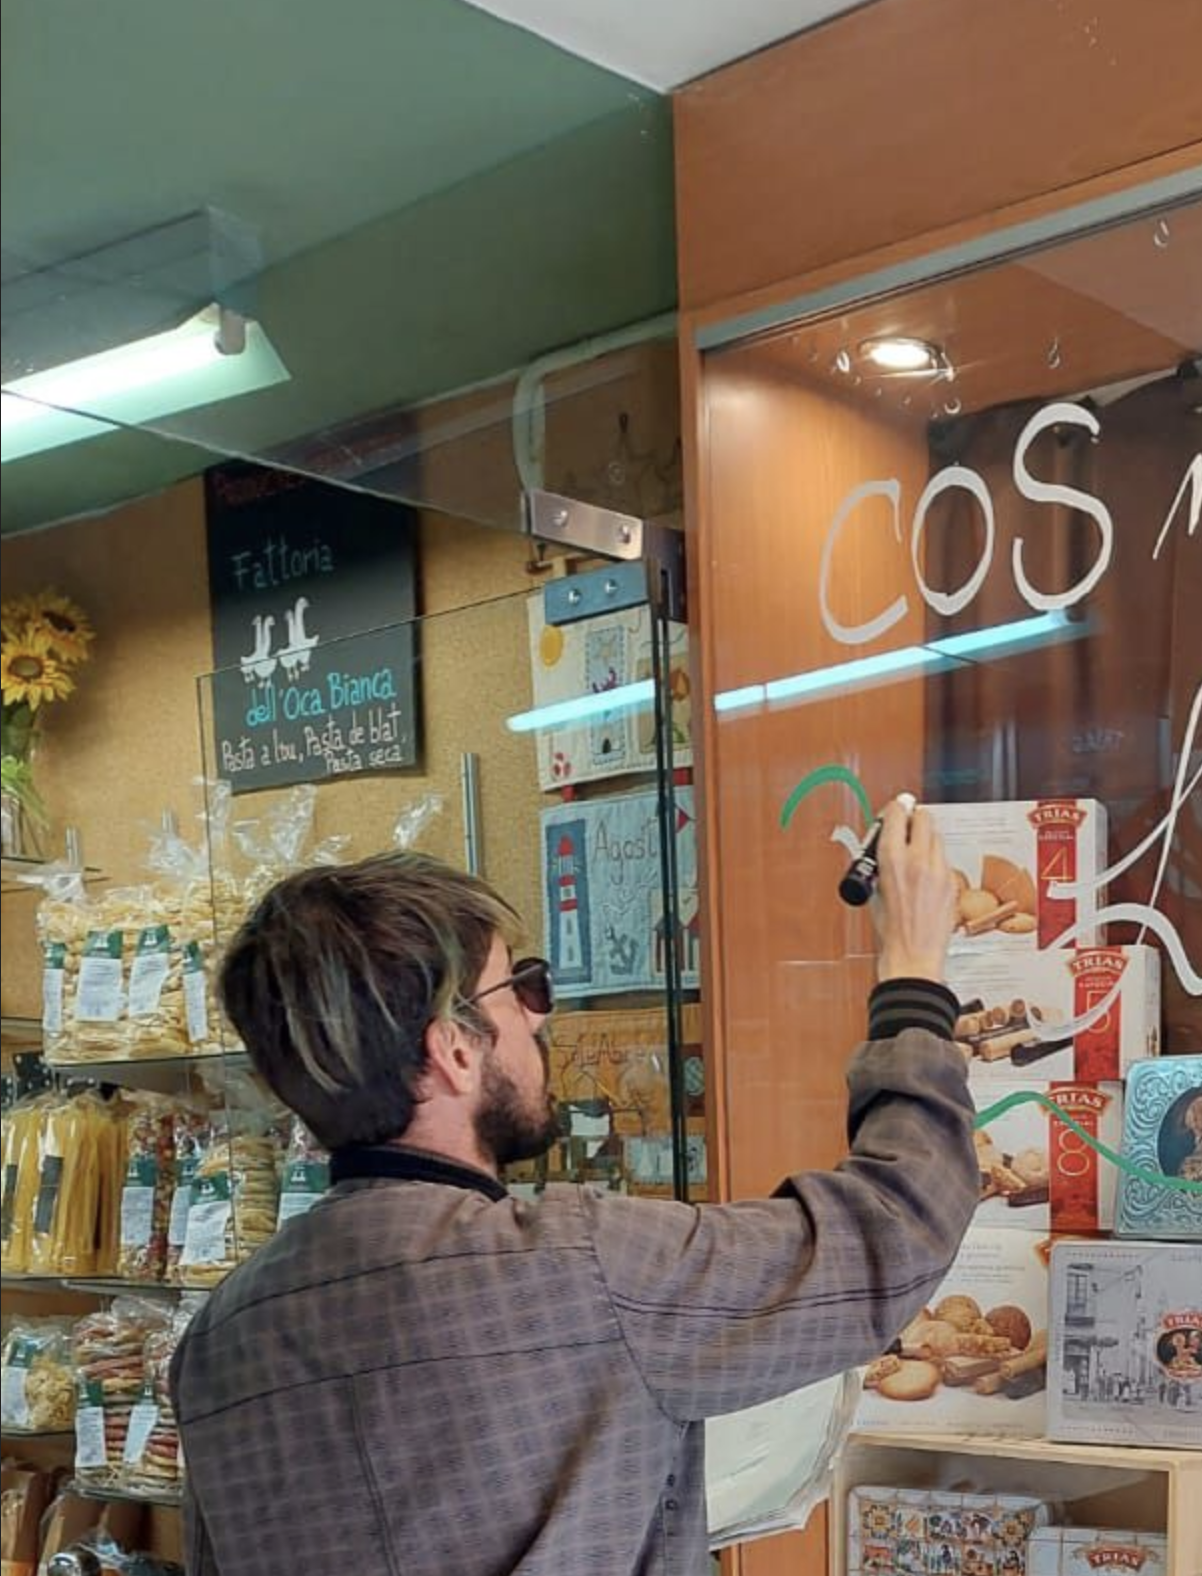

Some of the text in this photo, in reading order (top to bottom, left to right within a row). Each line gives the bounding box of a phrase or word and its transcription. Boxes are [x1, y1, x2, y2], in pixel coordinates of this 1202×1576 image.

[818, 402, 1113, 645] COS
[230, 533, 335, 592] Fattoria
[327, 668, 398, 710] Bianca
[222, 736, 256, 772] Pasta
[304, 713, 346, 756] Pasta
[350, 710, 366, 745] de
[324, 746, 363, 775] Pasta
[1034, 808, 1080, 822] TRIAS
[592, 817, 658, 887] Agost
[1040, 845, 1074, 883] 4
[1072, 955, 1123, 971] TRIAS
[1056, 1128, 1090, 1177] 8
